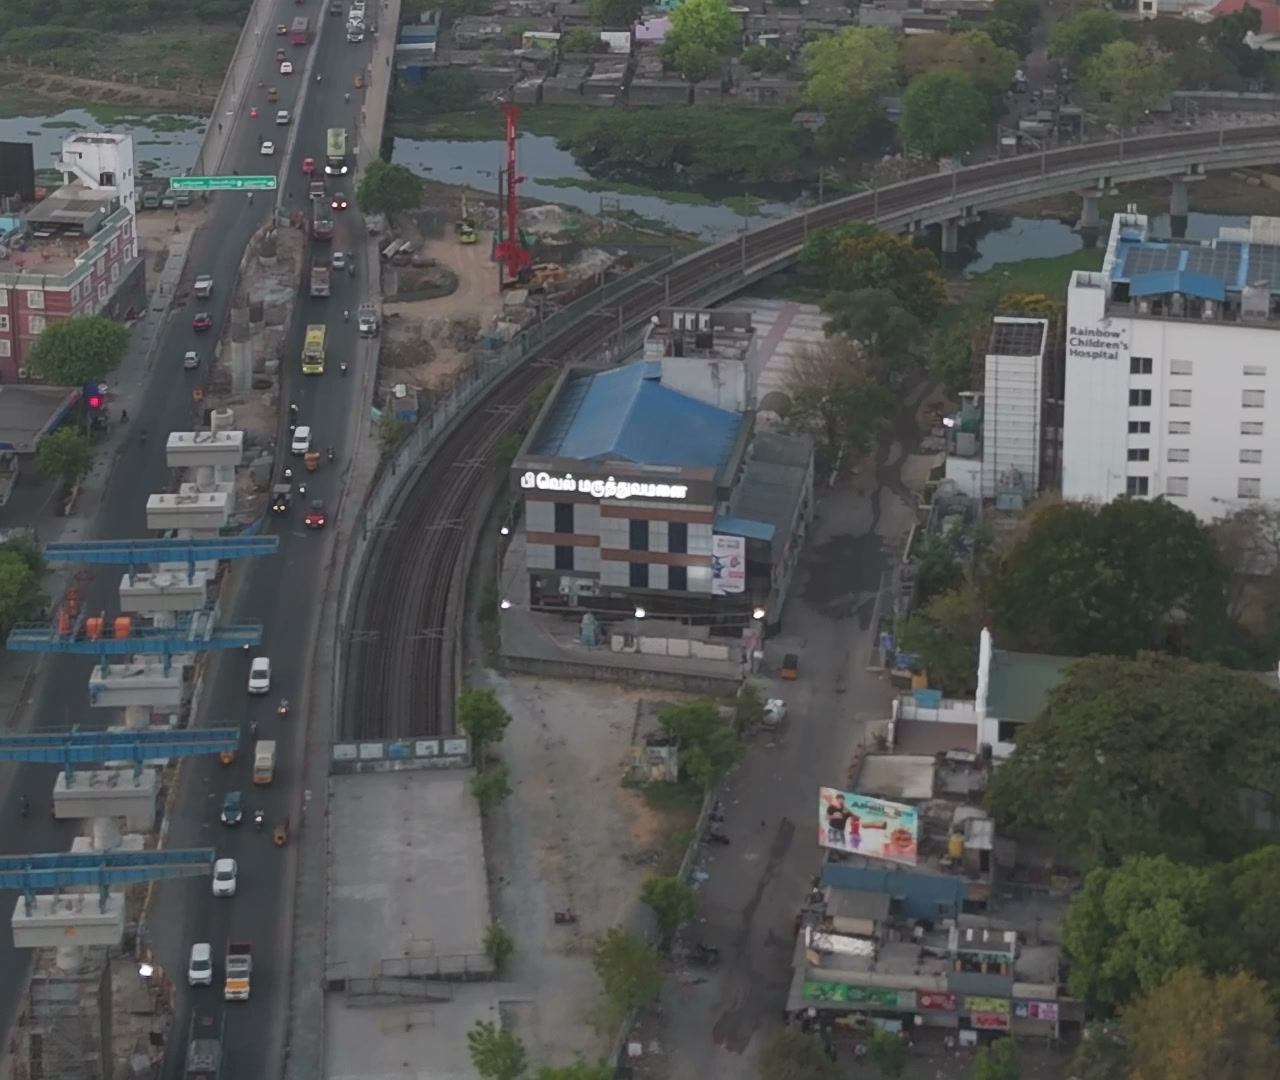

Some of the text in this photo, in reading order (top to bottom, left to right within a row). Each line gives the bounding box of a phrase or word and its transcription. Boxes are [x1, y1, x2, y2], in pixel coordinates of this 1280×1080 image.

[1070, 326, 1121, 338] Rainbow
[1069, 337, 1129, 351] Children's
[1069, 348, 1119, 360] Hospital
